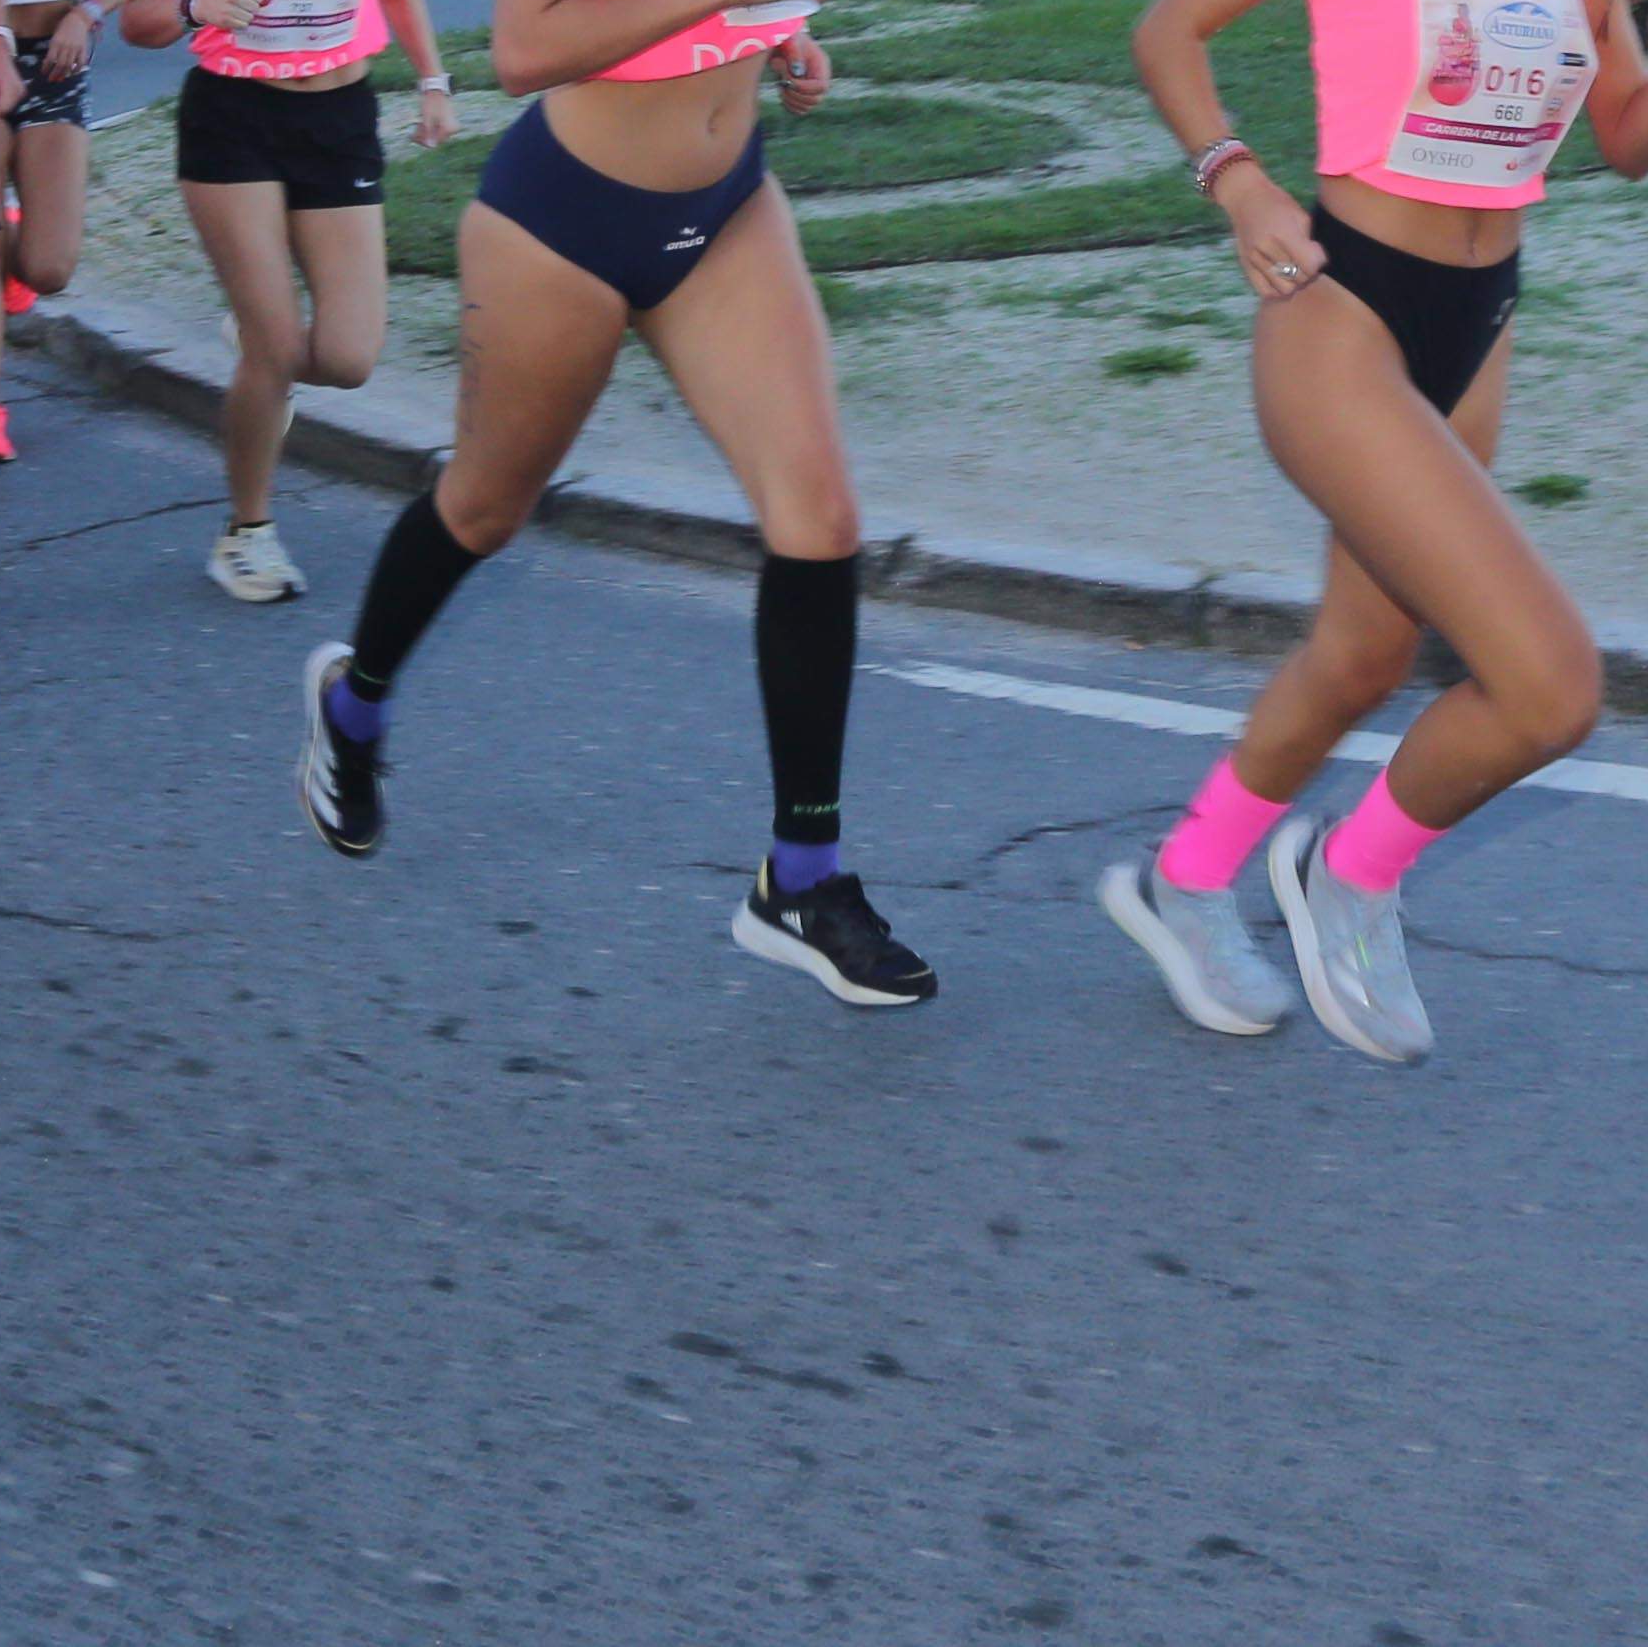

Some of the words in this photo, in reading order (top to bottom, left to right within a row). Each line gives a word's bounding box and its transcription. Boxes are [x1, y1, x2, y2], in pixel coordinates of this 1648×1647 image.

[1484, 65, 1546, 96] 016
[1494, 103, 1524, 122] 668
[1424, 122, 1482, 139] CARRERA
[1481, 130, 1500, 141] DE
[1411, 147, 1474, 169] OYSHO
